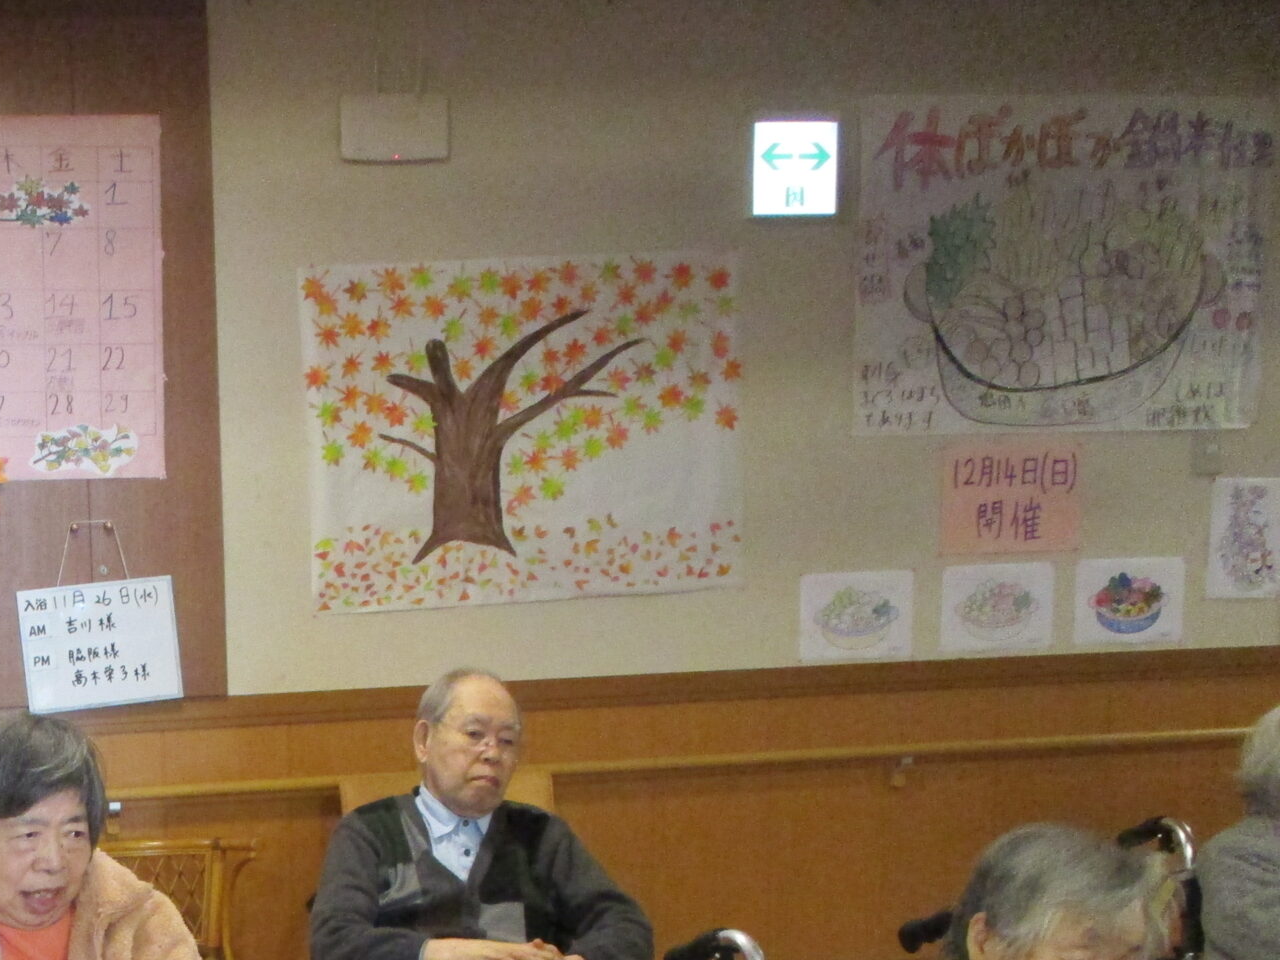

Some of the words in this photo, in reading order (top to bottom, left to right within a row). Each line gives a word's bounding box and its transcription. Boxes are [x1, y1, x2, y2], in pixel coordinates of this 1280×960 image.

[48, 147, 75, 174] 金
[111, 148, 132, 173] 土
[105, 181, 128, 205] 1
[45, 231, 62, 256] 7
[104, 229, 116, 257] 8
[43, 292, 78, 319] 14
[102, 293, 139, 321] 15
[45, 347, 76, 373] 21
[101, 346, 125, 371] 22
[48, 393, 74, 415] 28
[104, 394, 129, 414] 29
[953, 451, 1077, 494] 12月14日(日)
[977, 497, 1041, 541] 開催
[24, 598, 47, 612] 入浴
[29, 624, 46, 637] AM
[33, 655, 51, 667] PM
